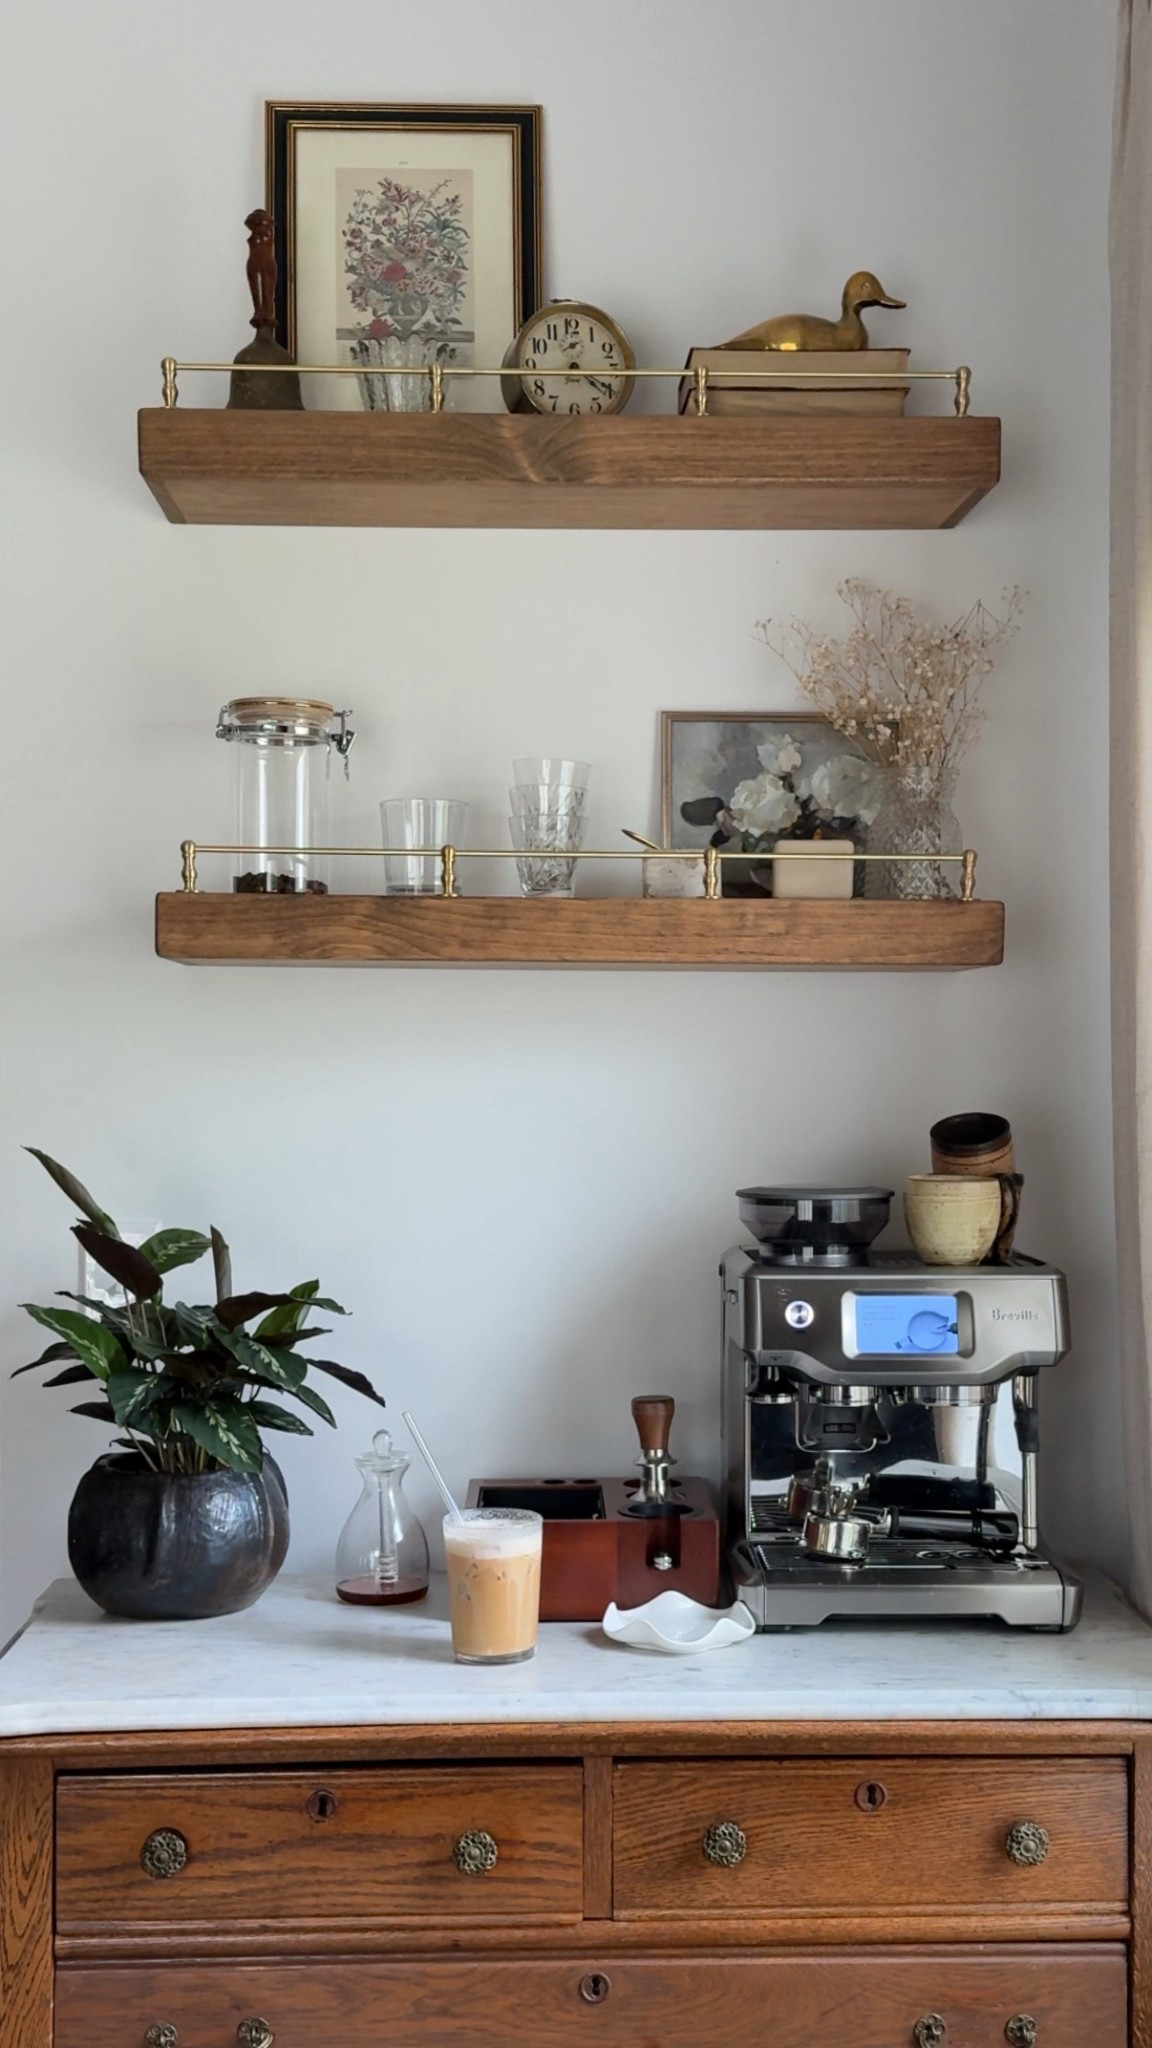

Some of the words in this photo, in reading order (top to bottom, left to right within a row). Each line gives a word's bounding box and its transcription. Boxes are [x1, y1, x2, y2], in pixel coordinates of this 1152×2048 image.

[547, 324, 558, 341] 11
[564, 318, 580, 335] 12
[589, 326, 594, 343] 1
[532, 337, 548, 355] 10
[601, 342, 613, 359] 2
[533, 379, 545, 397] 8
[548, 395, 559, 412] 7
[590, 397, 602, 414] 5
[991, 1308, 1039, 1321] Breville
